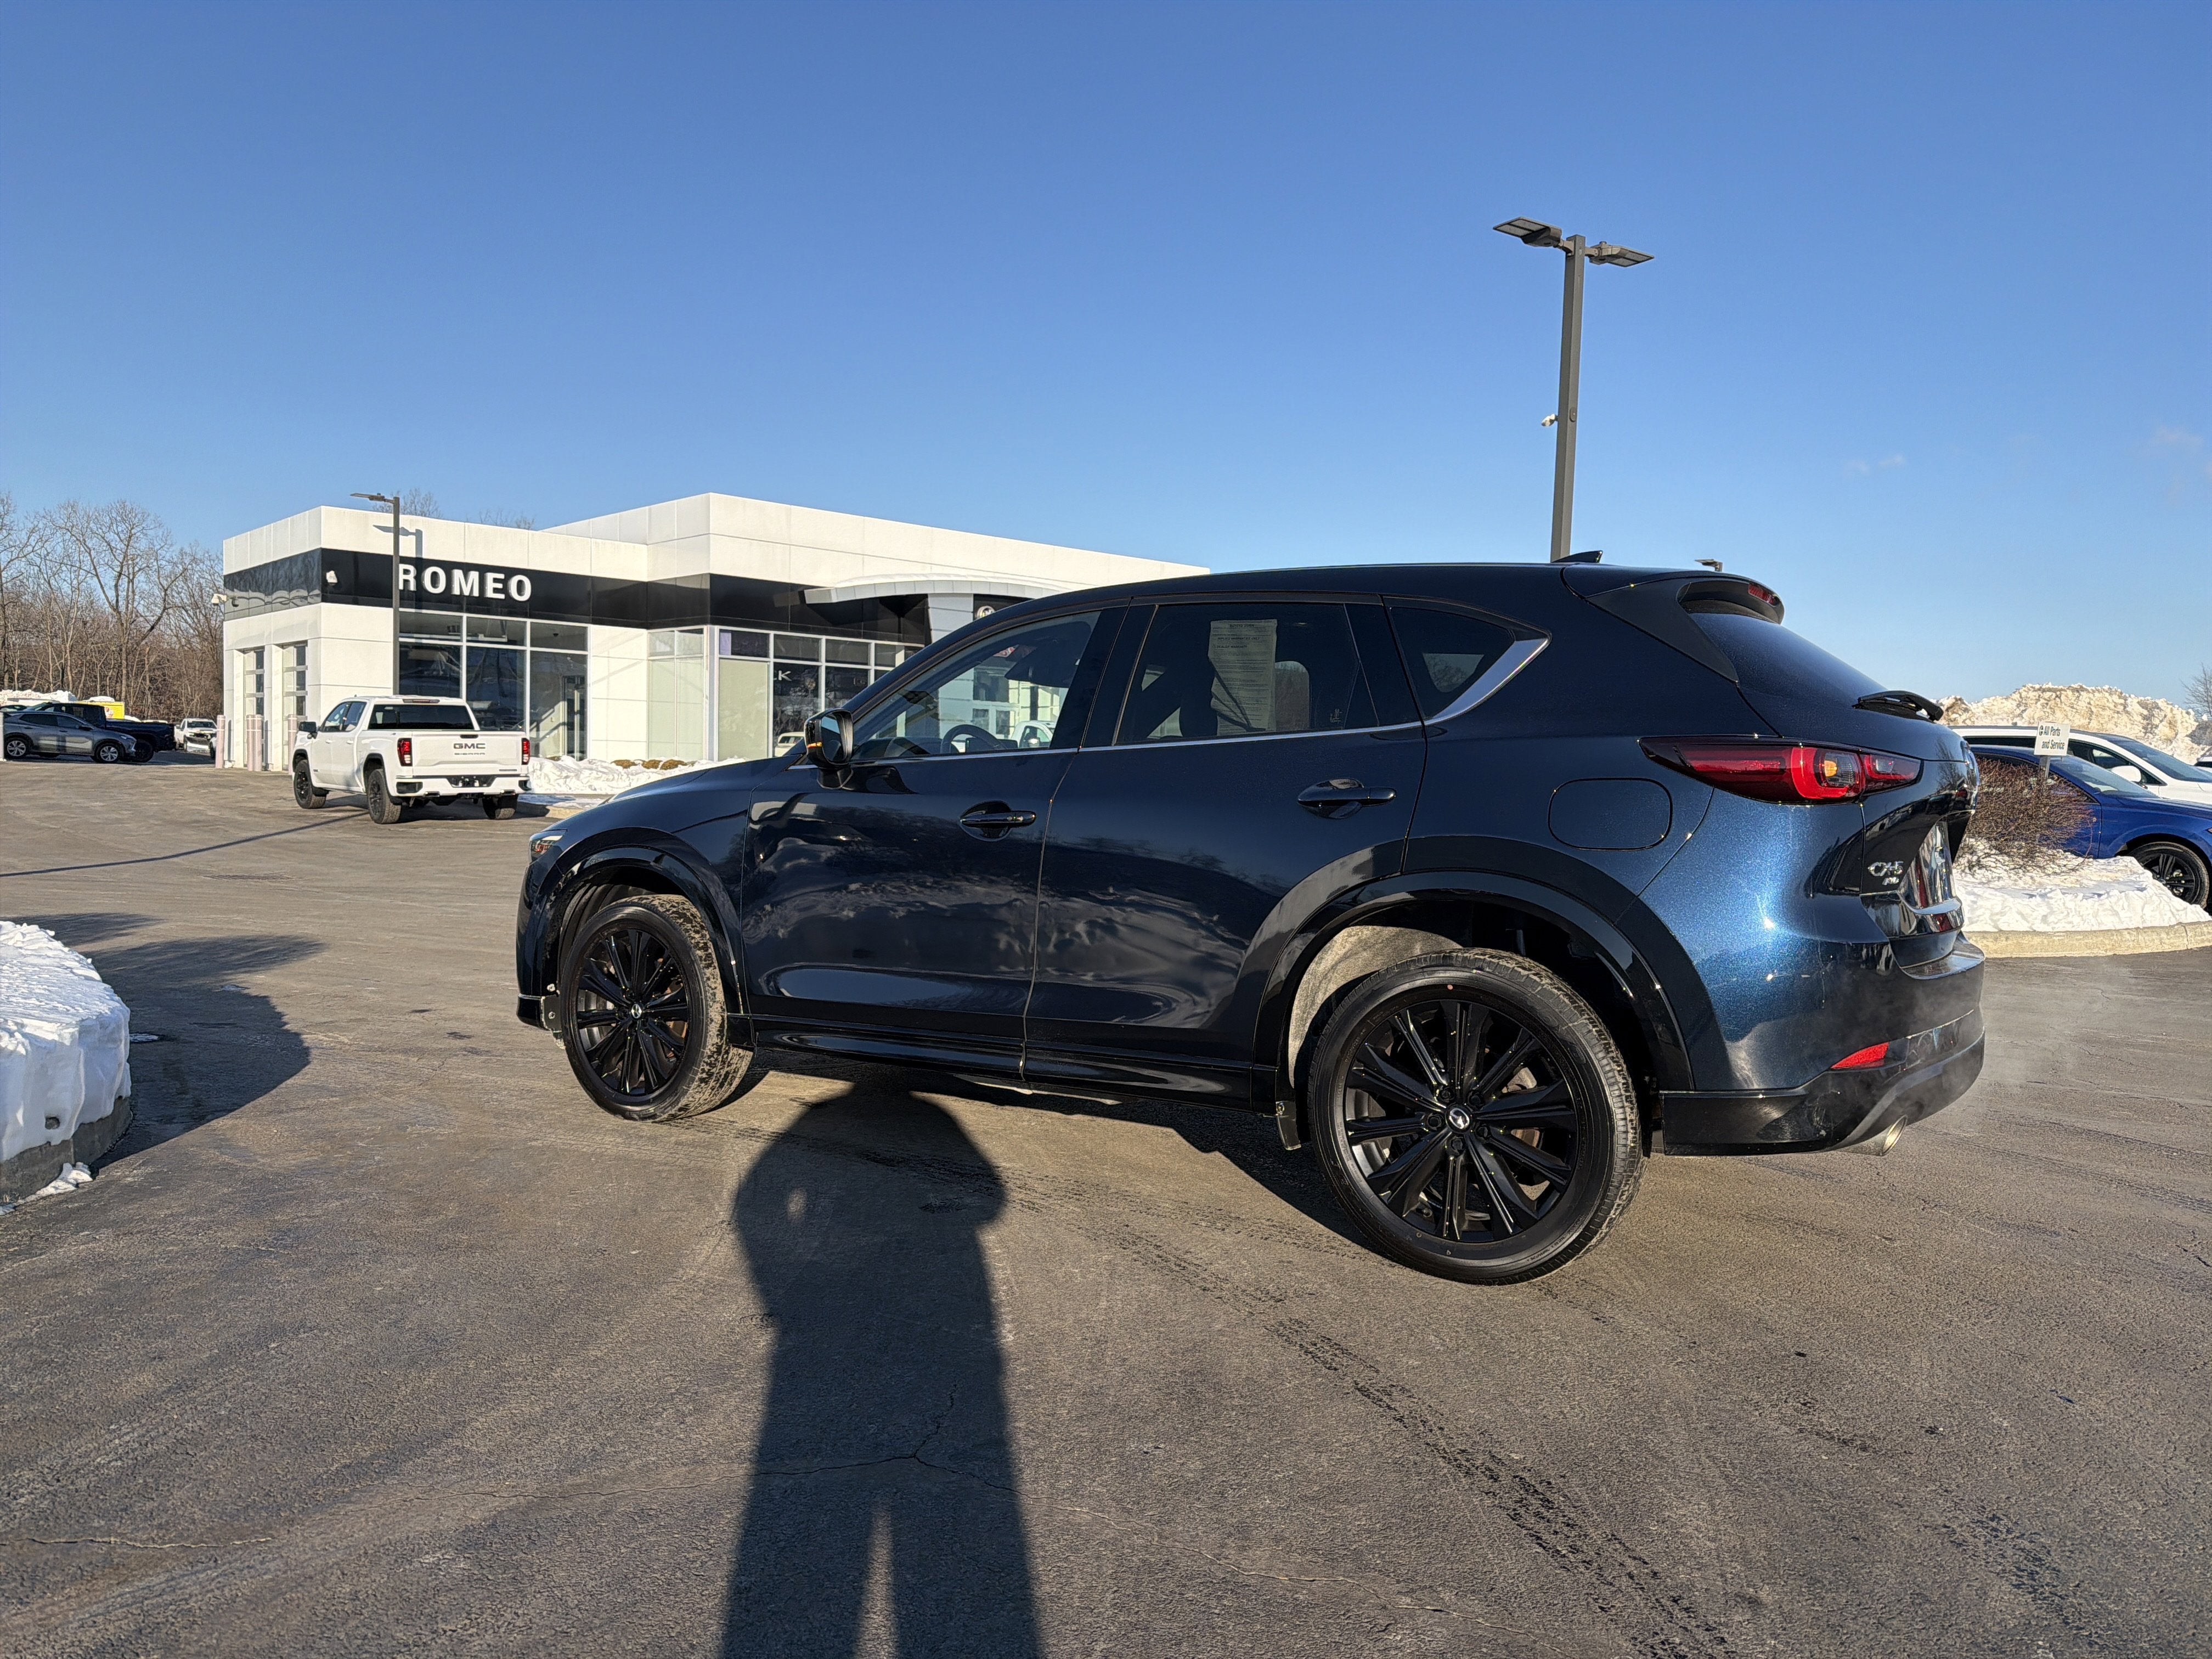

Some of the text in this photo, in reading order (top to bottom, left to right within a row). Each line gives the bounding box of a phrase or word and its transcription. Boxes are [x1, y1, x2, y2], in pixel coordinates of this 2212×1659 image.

[398, 563, 532, 602] ROMEO
[2050, 726, 2061, 736] Parts
[2041, 739, 2064, 749] and Service
